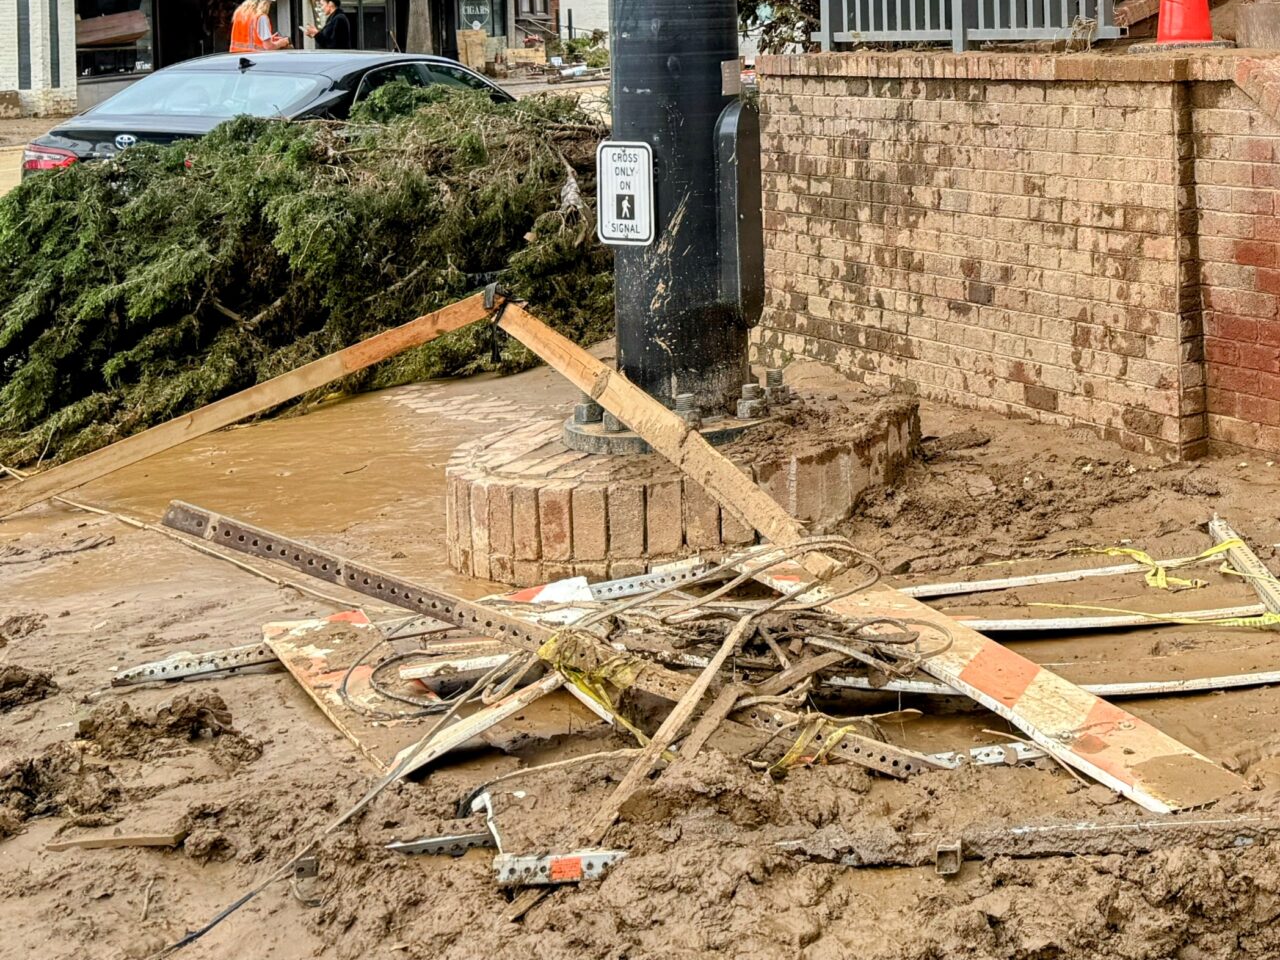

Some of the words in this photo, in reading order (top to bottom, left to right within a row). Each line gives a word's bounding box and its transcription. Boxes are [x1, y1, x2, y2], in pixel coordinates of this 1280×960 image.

[462, 5, 490, 15] CIGARS
[611, 152, 638, 163] CROSS
[614, 166, 636, 177] ONLY
[619, 181, 631, 191] ON
[611, 222, 640, 234] SIGNAL
